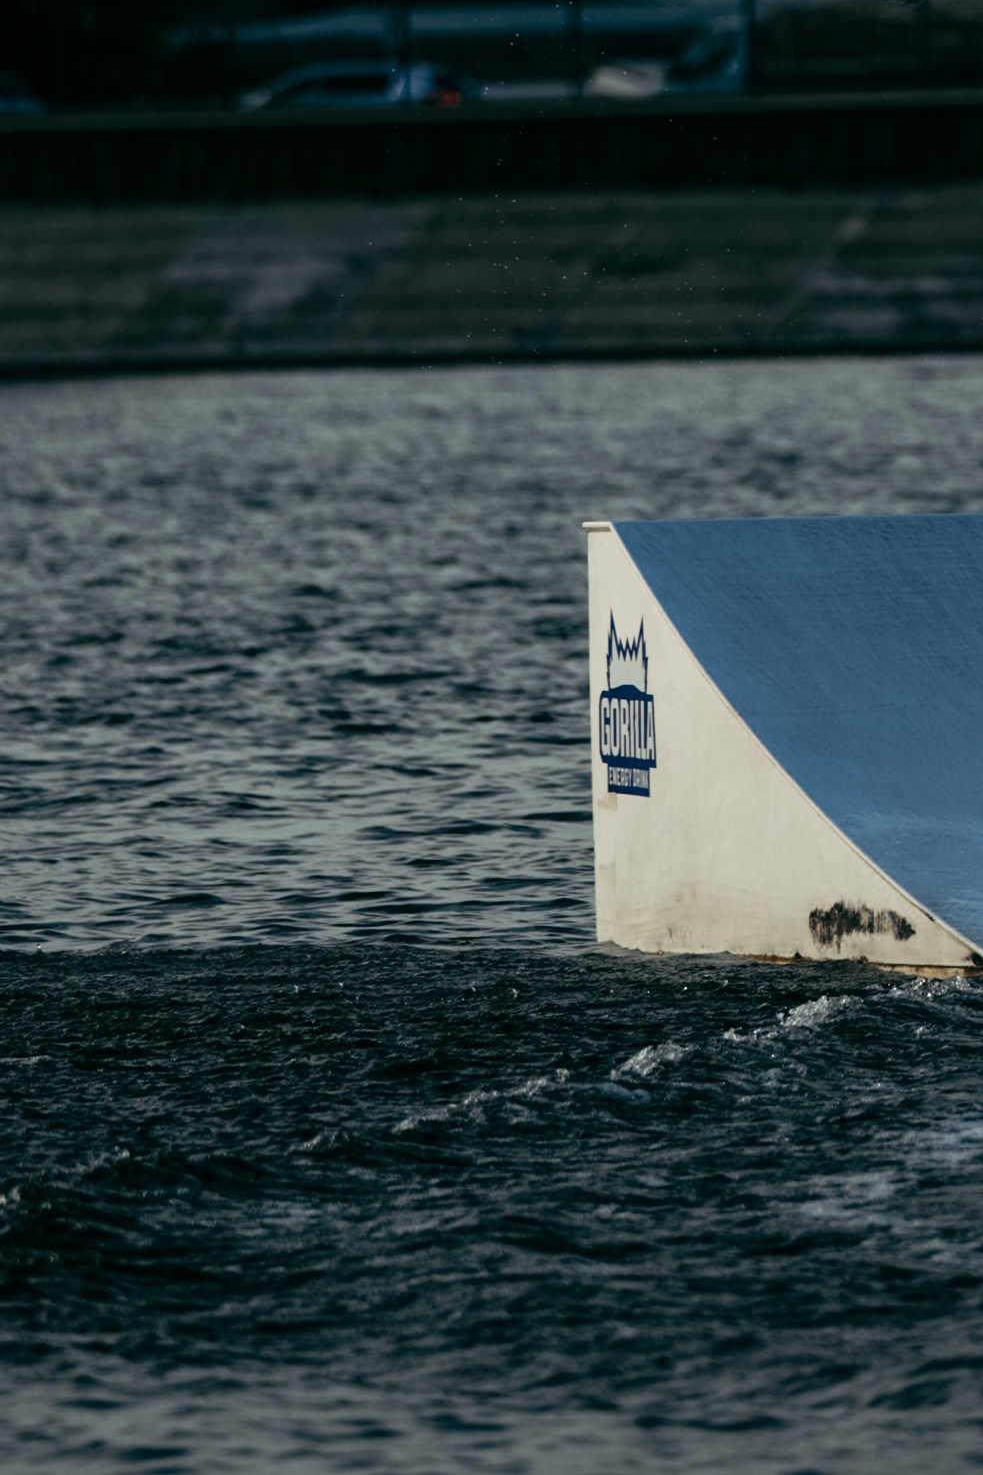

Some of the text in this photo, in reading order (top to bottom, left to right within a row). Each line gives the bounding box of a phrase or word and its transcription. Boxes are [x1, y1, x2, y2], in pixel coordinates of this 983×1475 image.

[601, 697, 655, 760] GORILLA
[609, 767, 649, 789] ENERGY DRINK
